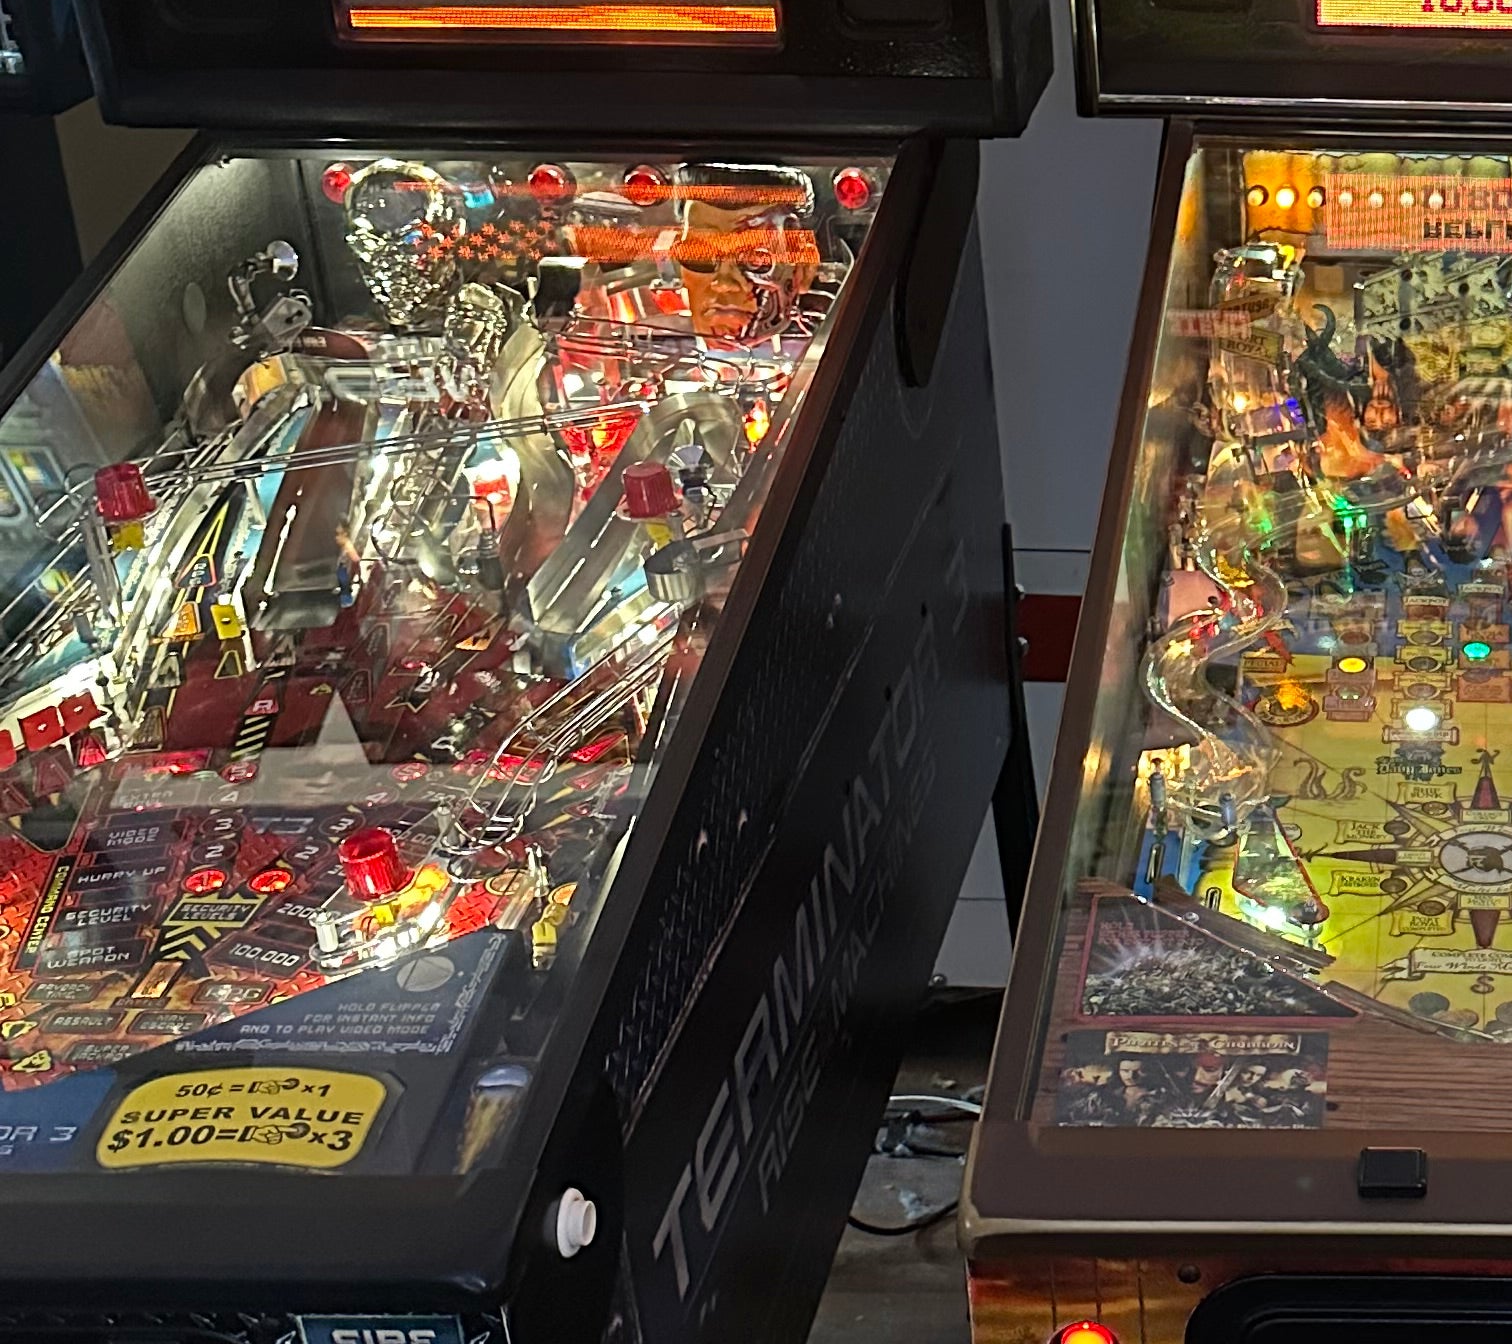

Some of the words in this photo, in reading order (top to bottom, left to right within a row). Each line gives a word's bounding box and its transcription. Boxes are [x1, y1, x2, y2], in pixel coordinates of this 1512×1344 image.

[106, 834, 158, 846] MODE
[109, 827, 160, 839] VIDEO
[78, 870, 136, 883] HURRY
[142, 866, 167, 877] UP
[65, 903, 152, 921] SECURITY
[77, 913, 131, 927] LEVEL
[66, 946, 116, 958] SPOT
[653, 613, 941, 1304] TERMINATOR
[47, 953, 130, 968] WEAPON
[338, 1002, 376, 1012] HOLD
[379, 1002, 441, 1012] FLIPPER
[53, 1015, 114, 1027] ASSAULT
[303, 1013, 332, 1023] FOR
[336, 1013, 397, 1023] INSTANT
[400, 1013, 436, 1023] INFO
[240, 1024, 270, 1034] AND
[274, 1024, 294, 1034] TO
[297, 1024, 334, 1034] PLAY
[339, 1024, 384, 1034] VIDEO
[386, 1024, 430, 1034] MODE
[175, 1083, 224, 1098] 50¢
[302, 1084, 331, 1098] x1
[120, 1106, 235, 1125] SUPER
[250, 1106, 365, 1126] VALUE
[49, 1125, 77, 1142] 3
[308, 1130, 353, 1151] x3
